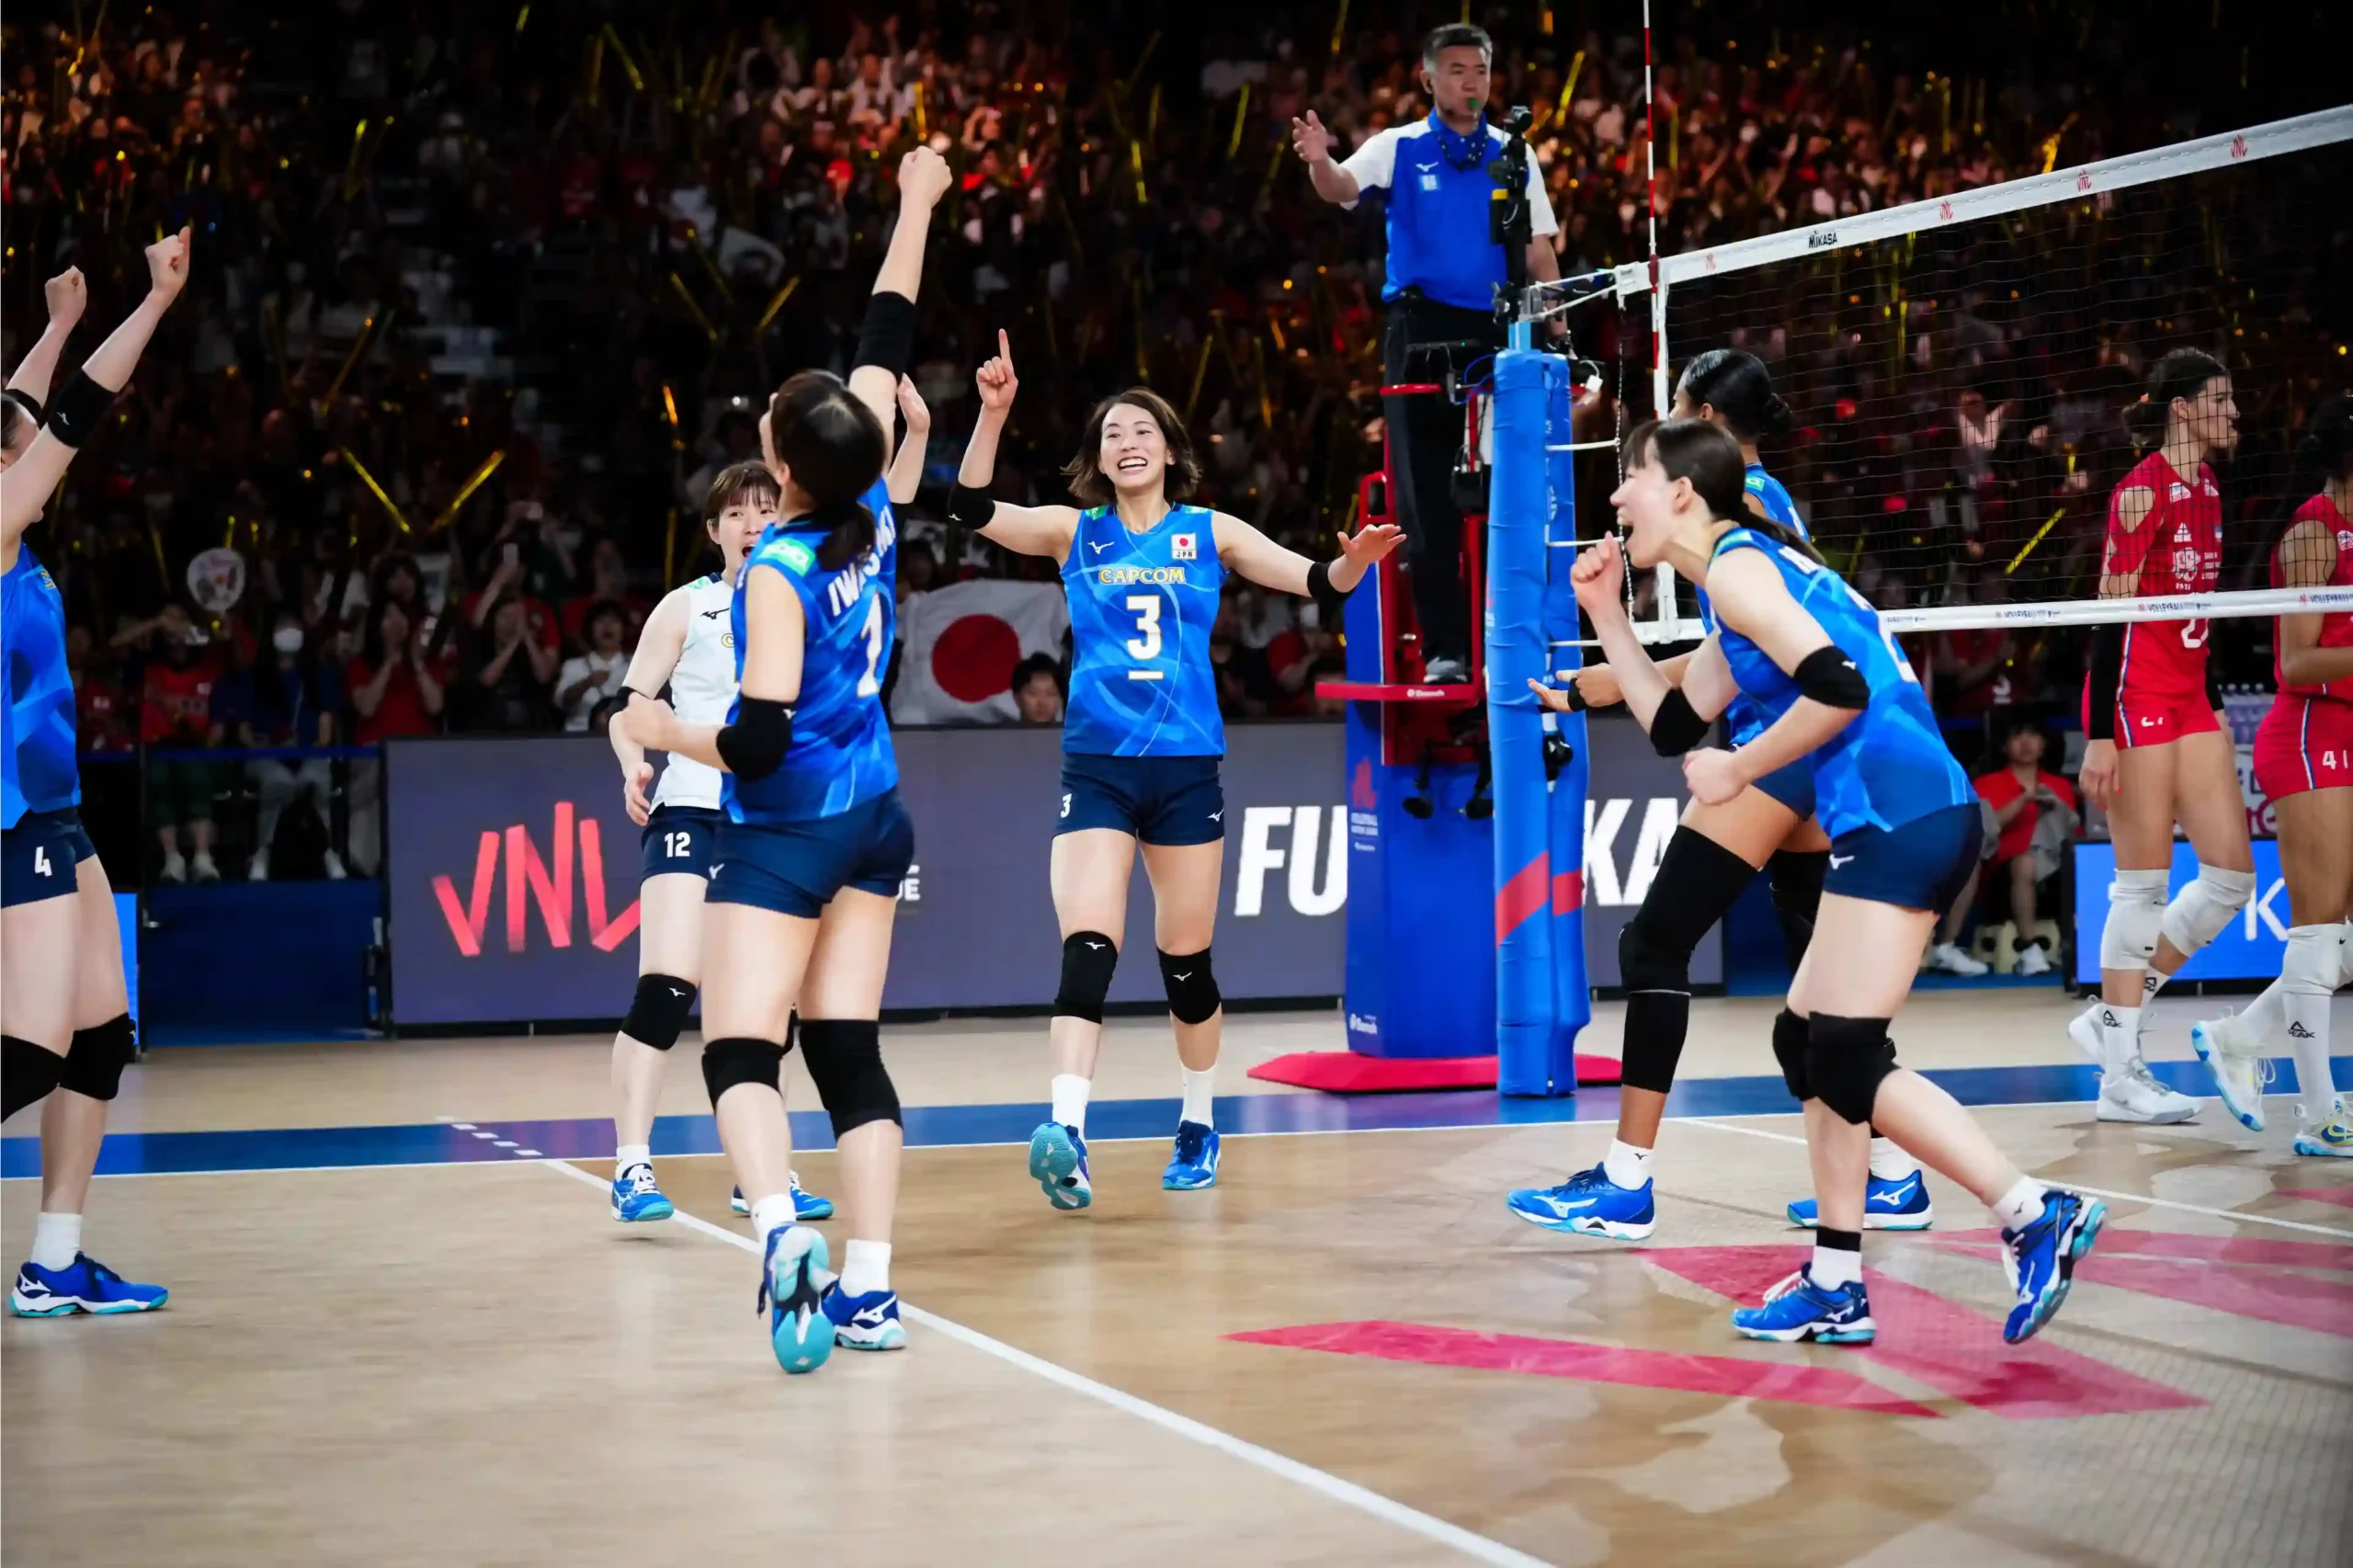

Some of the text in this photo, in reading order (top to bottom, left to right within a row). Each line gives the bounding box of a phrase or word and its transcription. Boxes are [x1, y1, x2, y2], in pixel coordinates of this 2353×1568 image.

[1809, 230, 1838, 248] MIKASA
[1099, 567, 1186, 584] CAPCOM
[1126, 595, 1162, 661] 3
[857, 592, 883, 697] 1
[1060, 794, 1073, 818] 3
[664, 831, 691, 858] 12
[34, 846, 52, 877] 4
[431, 801, 642, 957] VNL
